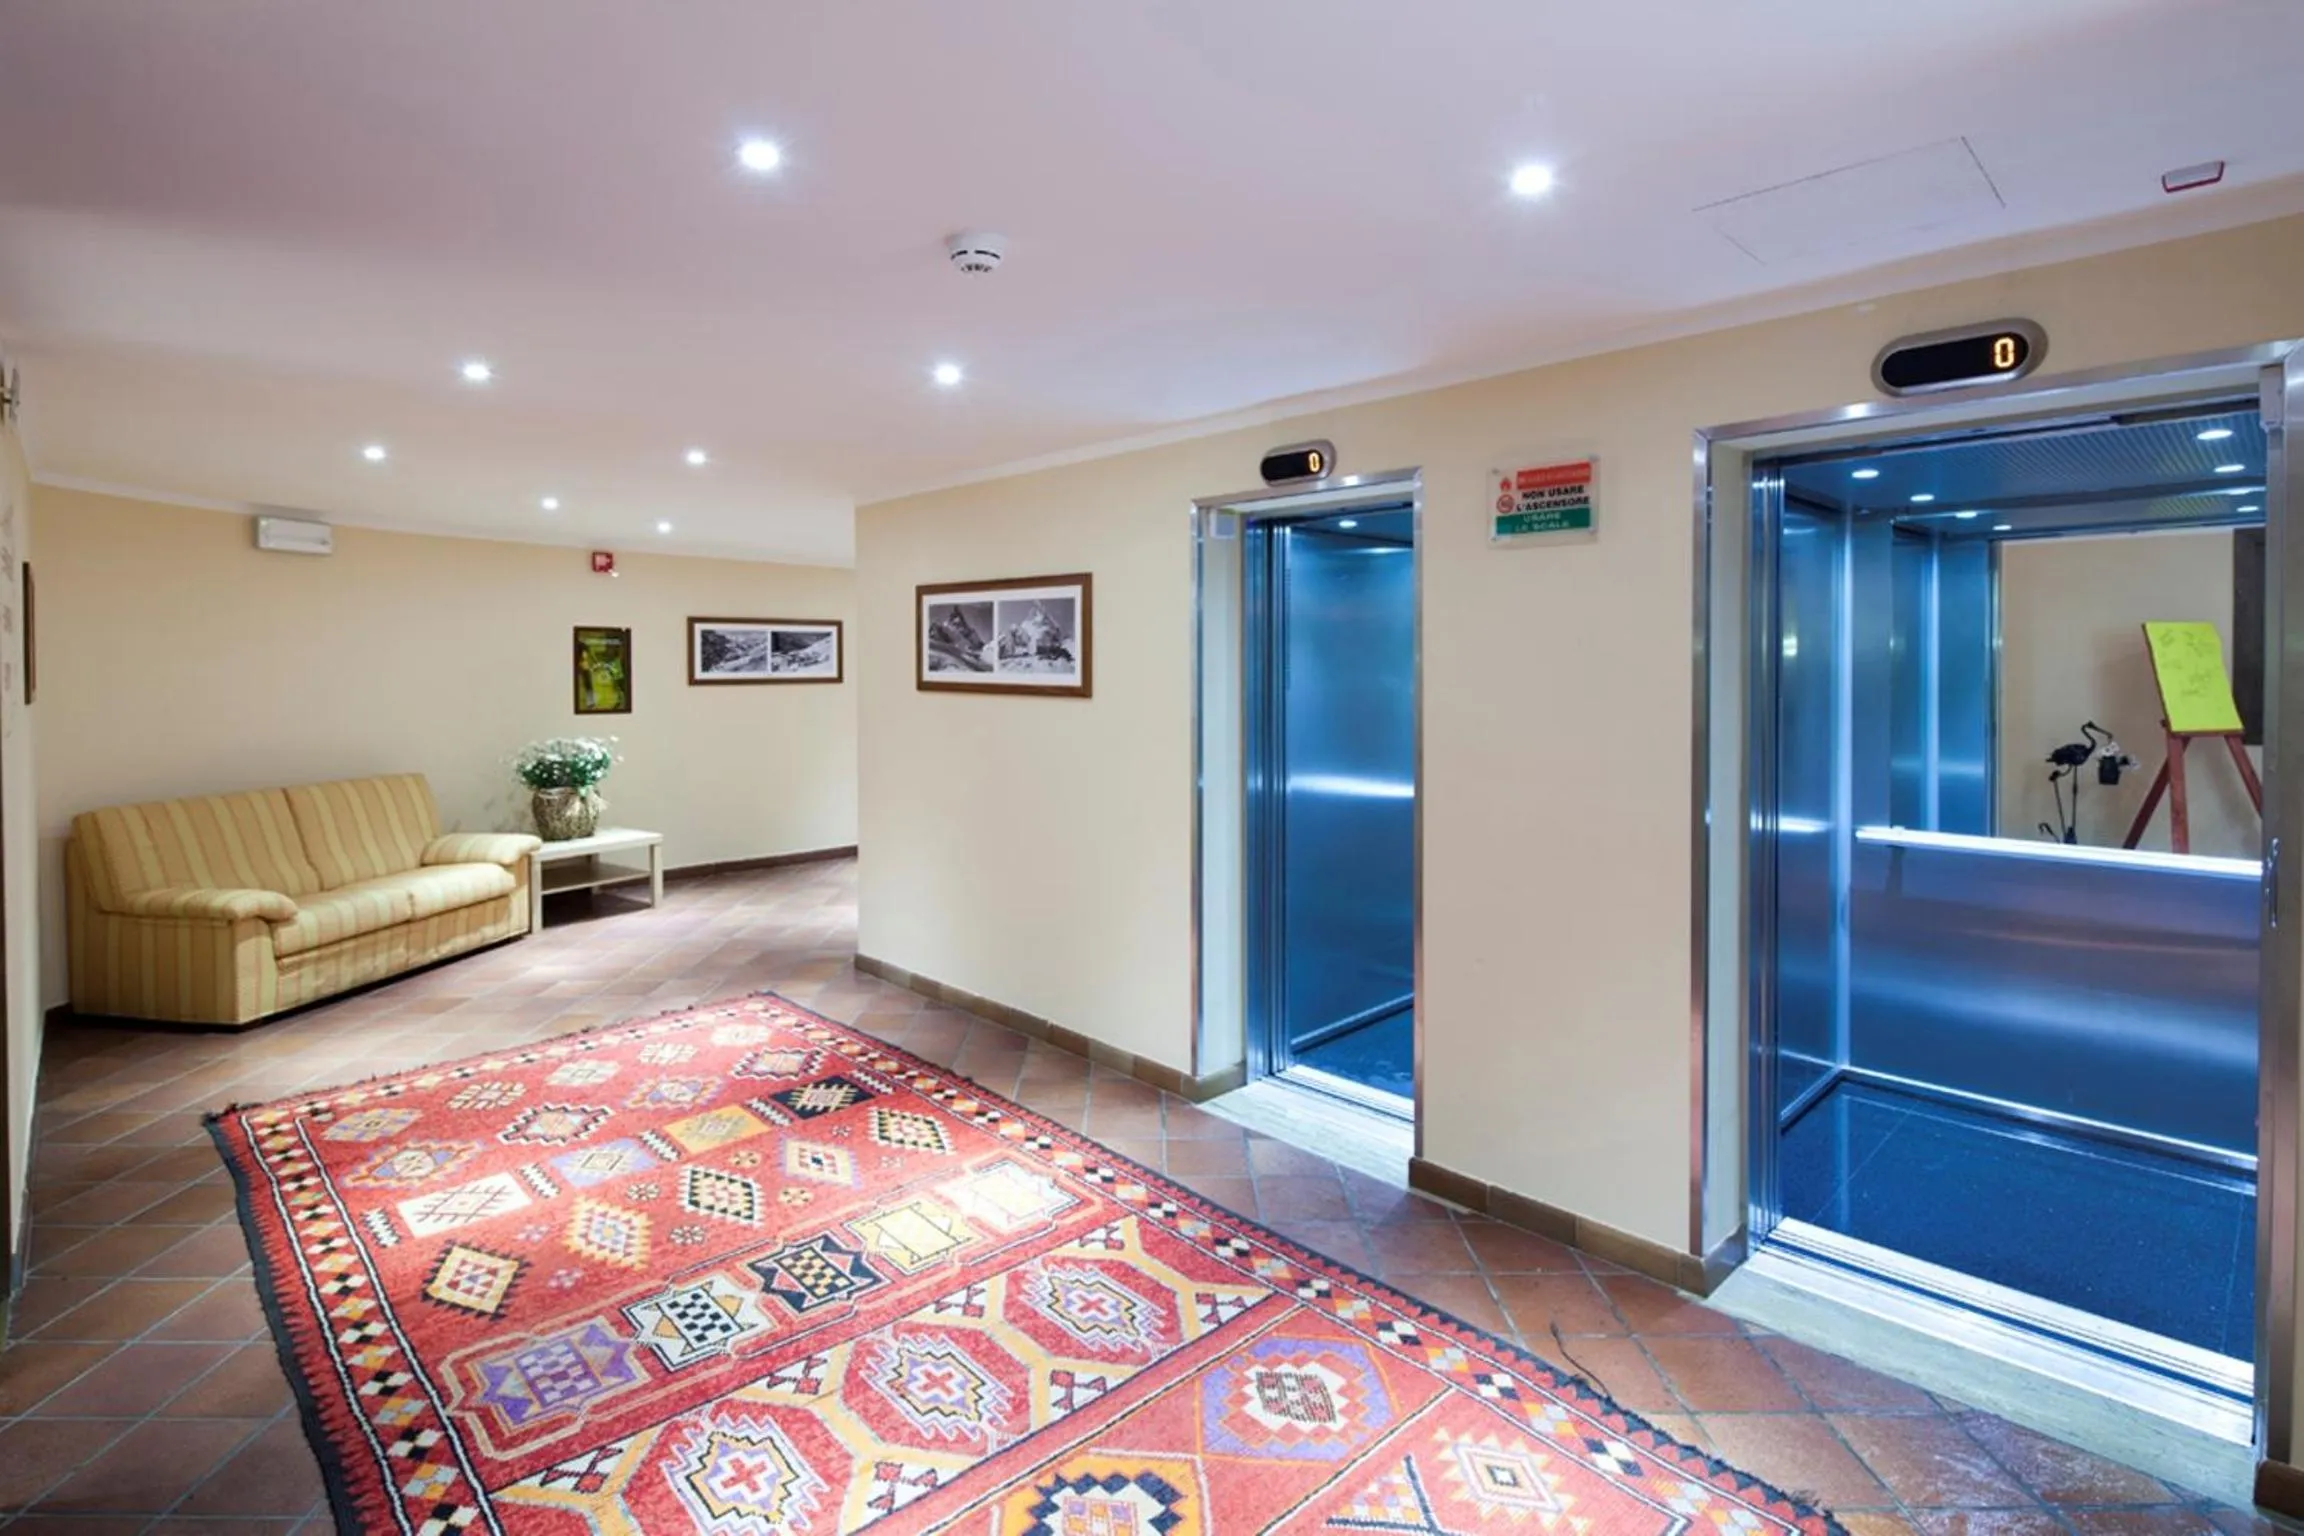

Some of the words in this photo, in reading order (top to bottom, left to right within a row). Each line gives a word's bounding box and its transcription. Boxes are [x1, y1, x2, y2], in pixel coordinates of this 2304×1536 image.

[1994, 336, 2014, 369] 0
[1308, 452, 1320, 473] 0
[1522, 489, 1545, 500] NON
[1548, 485, 1584, 497] USARE
[1516, 496, 1590, 512] L'ASCENSORE
